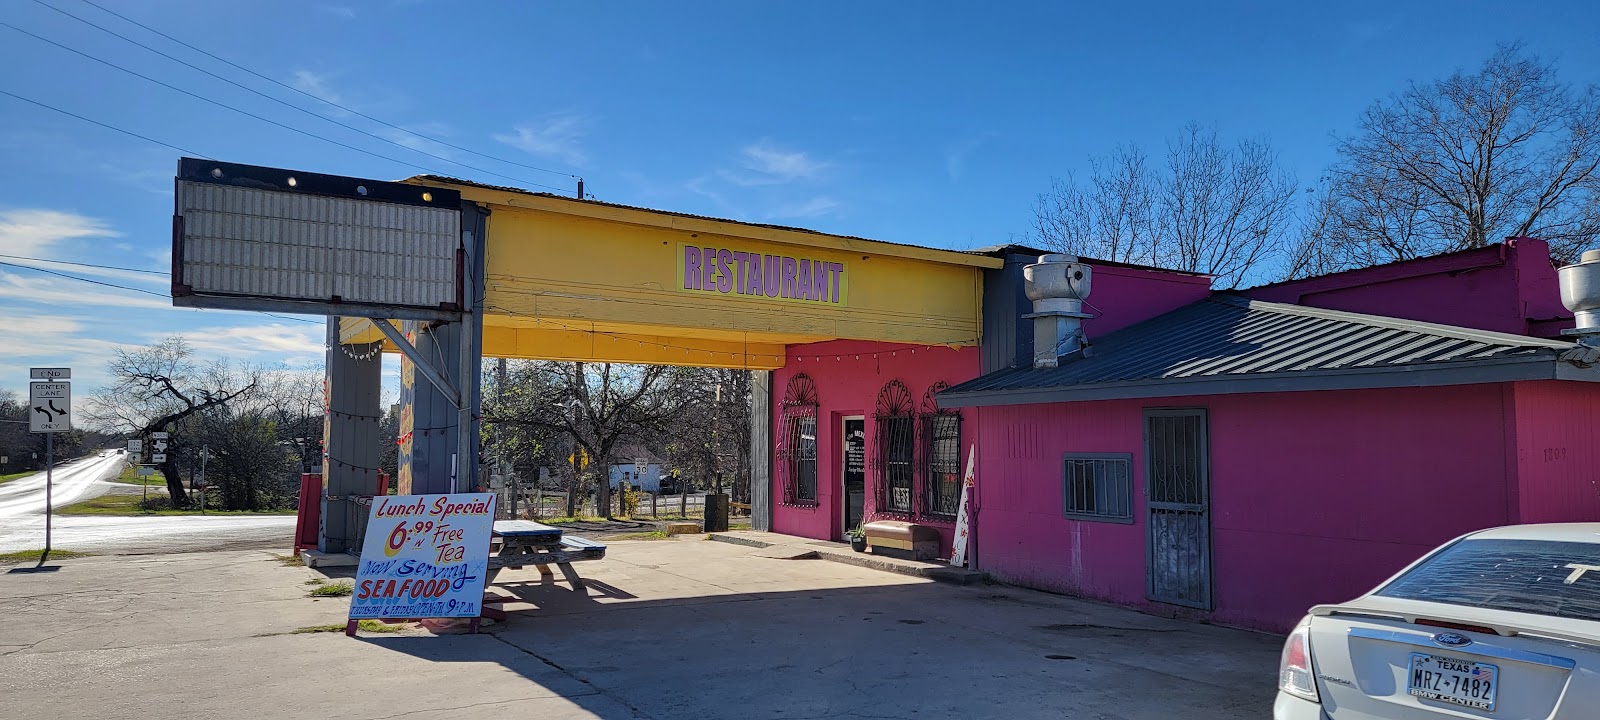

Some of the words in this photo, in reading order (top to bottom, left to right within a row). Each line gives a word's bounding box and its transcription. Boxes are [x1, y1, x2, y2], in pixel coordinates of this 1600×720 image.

[684, 245, 844, 304] RESTAURANT
[377, 497, 426, 517] Lunch
[430, 495, 494, 522] Special
[433, 523, 464, 544] Free
[436, 543, 466, 562] Tea
[397, 559, 477, 590] Serving
[358, 578, 451, 599] SEAFOOD
[1438, 632, 1463, 644] Ford
[1437, 660, 1470, 673] TEXAS
[1411, 689, 1438, 700] BMW
[1440, 694, 1489, 710] CENTER
